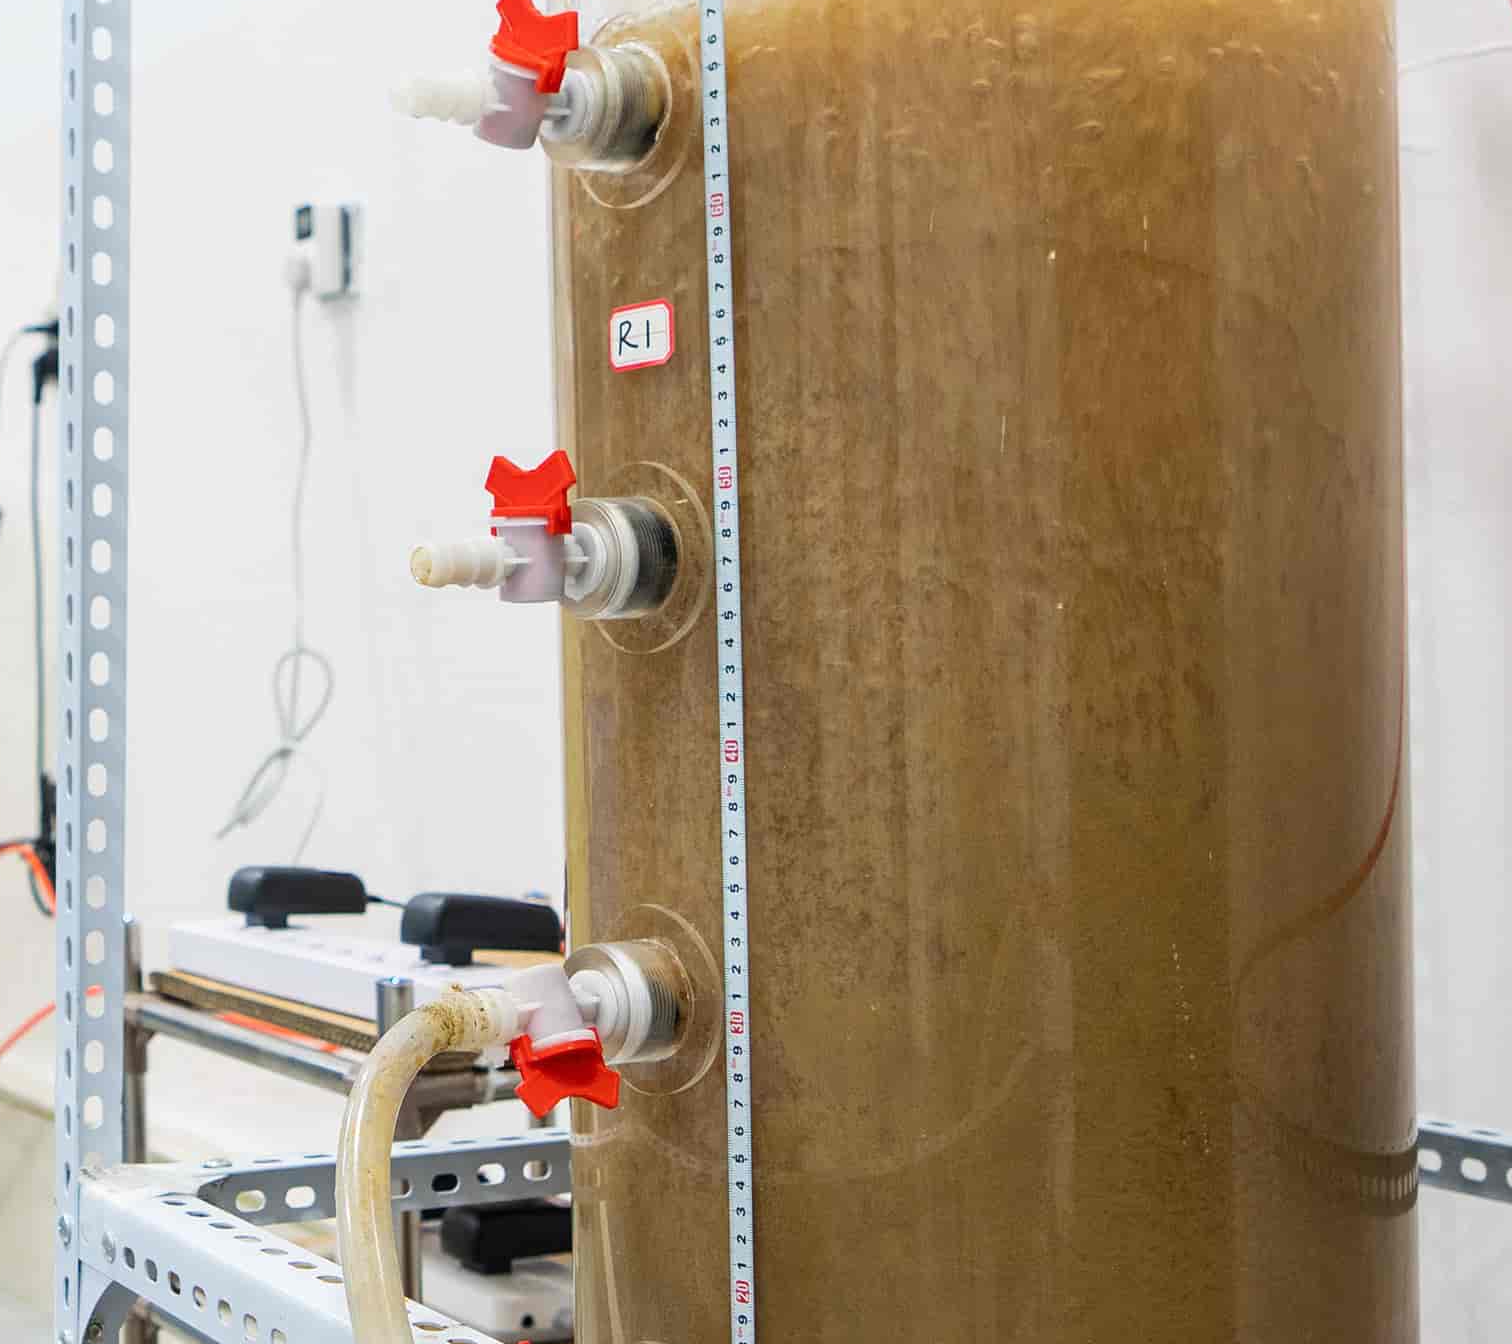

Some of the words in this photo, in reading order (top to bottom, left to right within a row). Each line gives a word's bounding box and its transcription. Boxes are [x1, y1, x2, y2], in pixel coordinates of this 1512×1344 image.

[706, 8, 716, 16] 7
[707, 34, 717, 44] 6
[708, 61, 718, 71] 5
[708, 89, 719, 99] 4
[709, 116, 720, 127] 3
[710, 143, 721, 153] 2
[712, 226, 723, 236] 9
[713, 253, 724, 263] 8
[714, 282, 725, 291] 7
[715, 308, 726, 318] 6
[716, 336, 726, 346] 5
[716, 363, 727, 374] 4
[717, 391, 728, 400] 3
[718, 418, 729, 427] 2
[720, 500, 731, 510] 9
[721, 527, 732, 538] 8
[722, 555, 732, 565] 7
[722, 582, 733, 592] 6
[723, 610, 734, 620] 5
[724, 637, 735, 647] 4
[725, 664, 735, 674] 3
[725, 692, 736, 702] 2
[727, 773, 738, 785] 9
[728, 802, 738, 811] 8
[728, 828, 739, 838] 7
[729, 855, 739, 865] 6
[729, 883, 740, 893] 5
[730, 910, 741, 920] 4
[730, 937, 741, 946] 3
[731, 964, 742, 974] 2
[732, 1045, 743, 1055] 9
[733, 1073, 744, 1083] 8
[733, 1099, 744, 1108] 7
[734, 1126, 745, 1136] 6
[734, 1154, 745, 1163] 5
[735, 1180, 746, 1190] 4
[735, 1206, 746, 1216] 3
[736, 1234, 747, 1244] 2
[737, 1314, 748, 1324] 9
